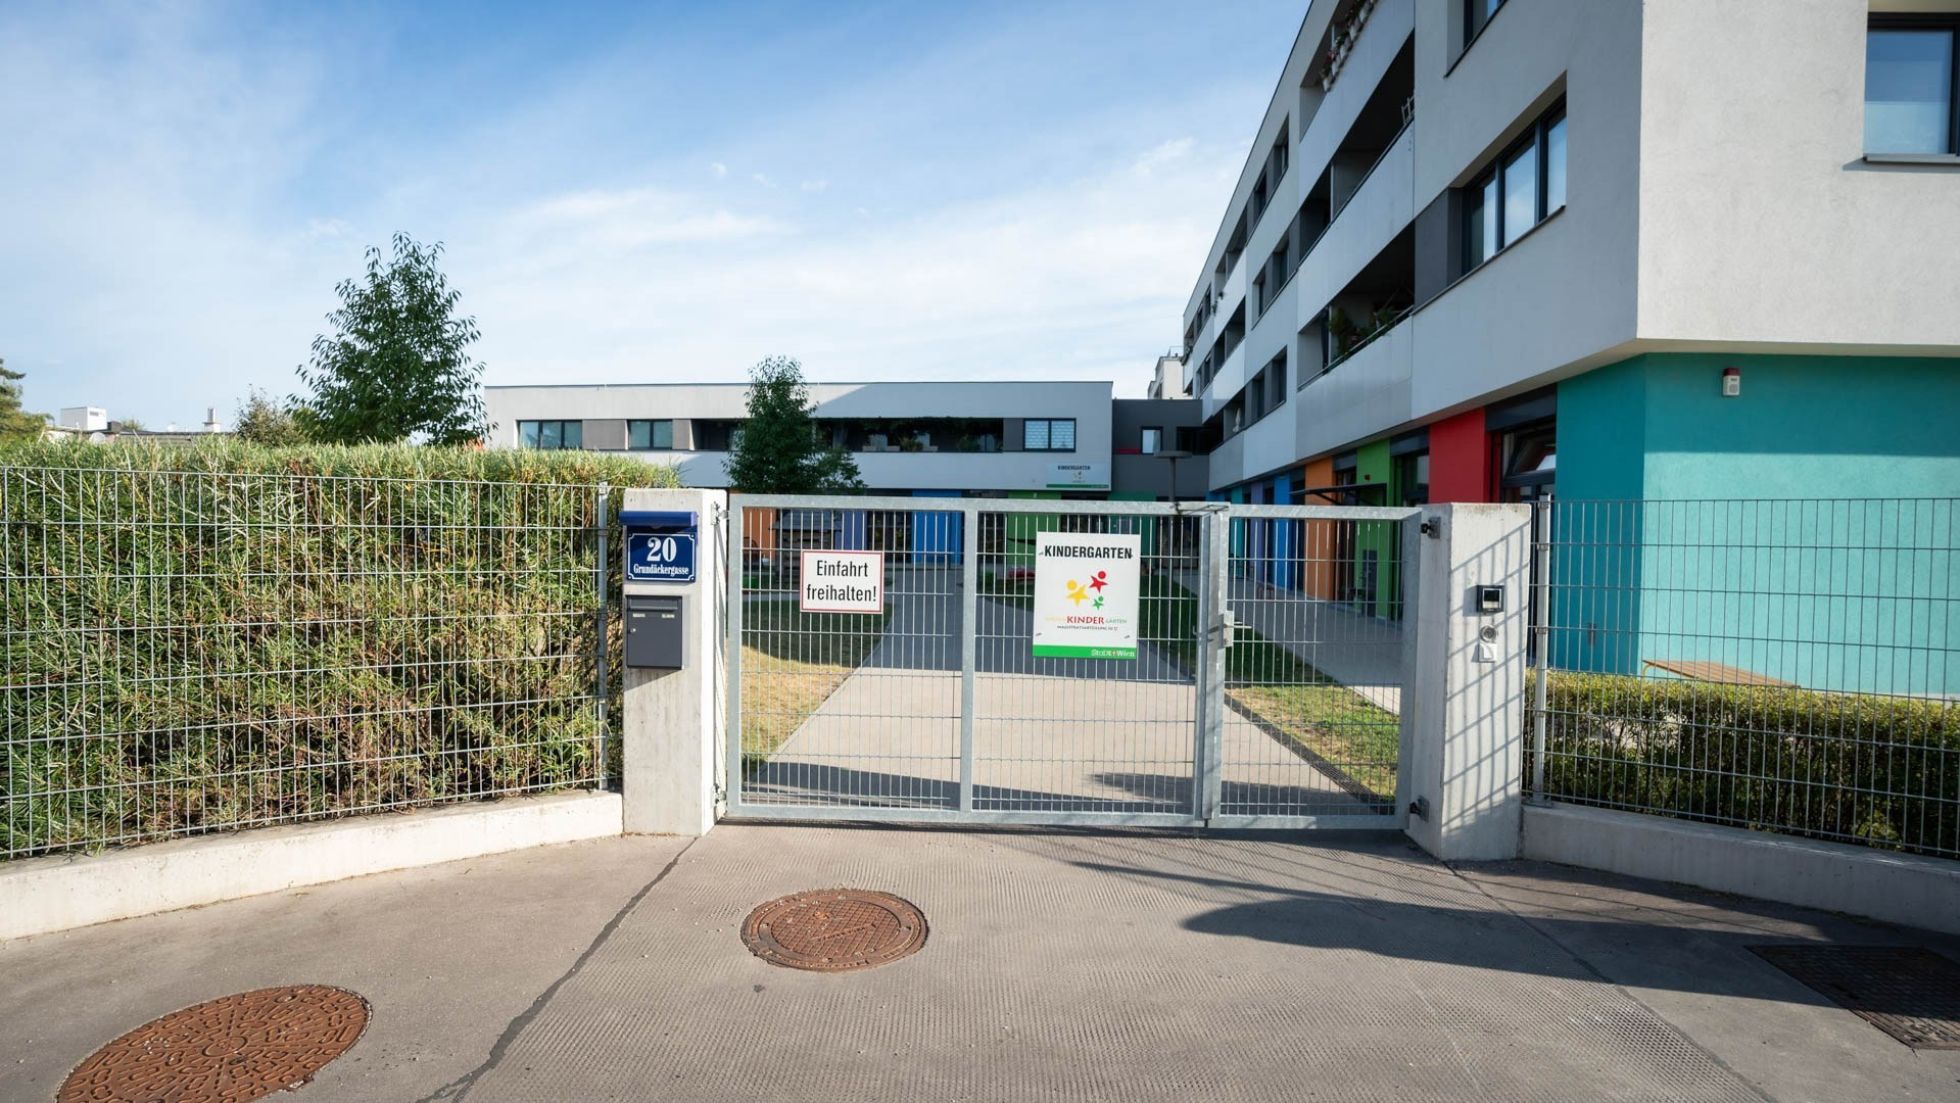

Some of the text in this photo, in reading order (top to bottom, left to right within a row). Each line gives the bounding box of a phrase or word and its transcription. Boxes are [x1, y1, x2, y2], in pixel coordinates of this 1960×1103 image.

[646, 536, 677, 562] 20
[1044, 545, 1132, 559] KINDERGARTEN
[633, 563, 689, 577] Grundäckergasse
[816, 559, 868, 577] Einfahrt
[806, 583, 876, 602] freihalten!
[1066, 615, 1104, 625] KINDER
